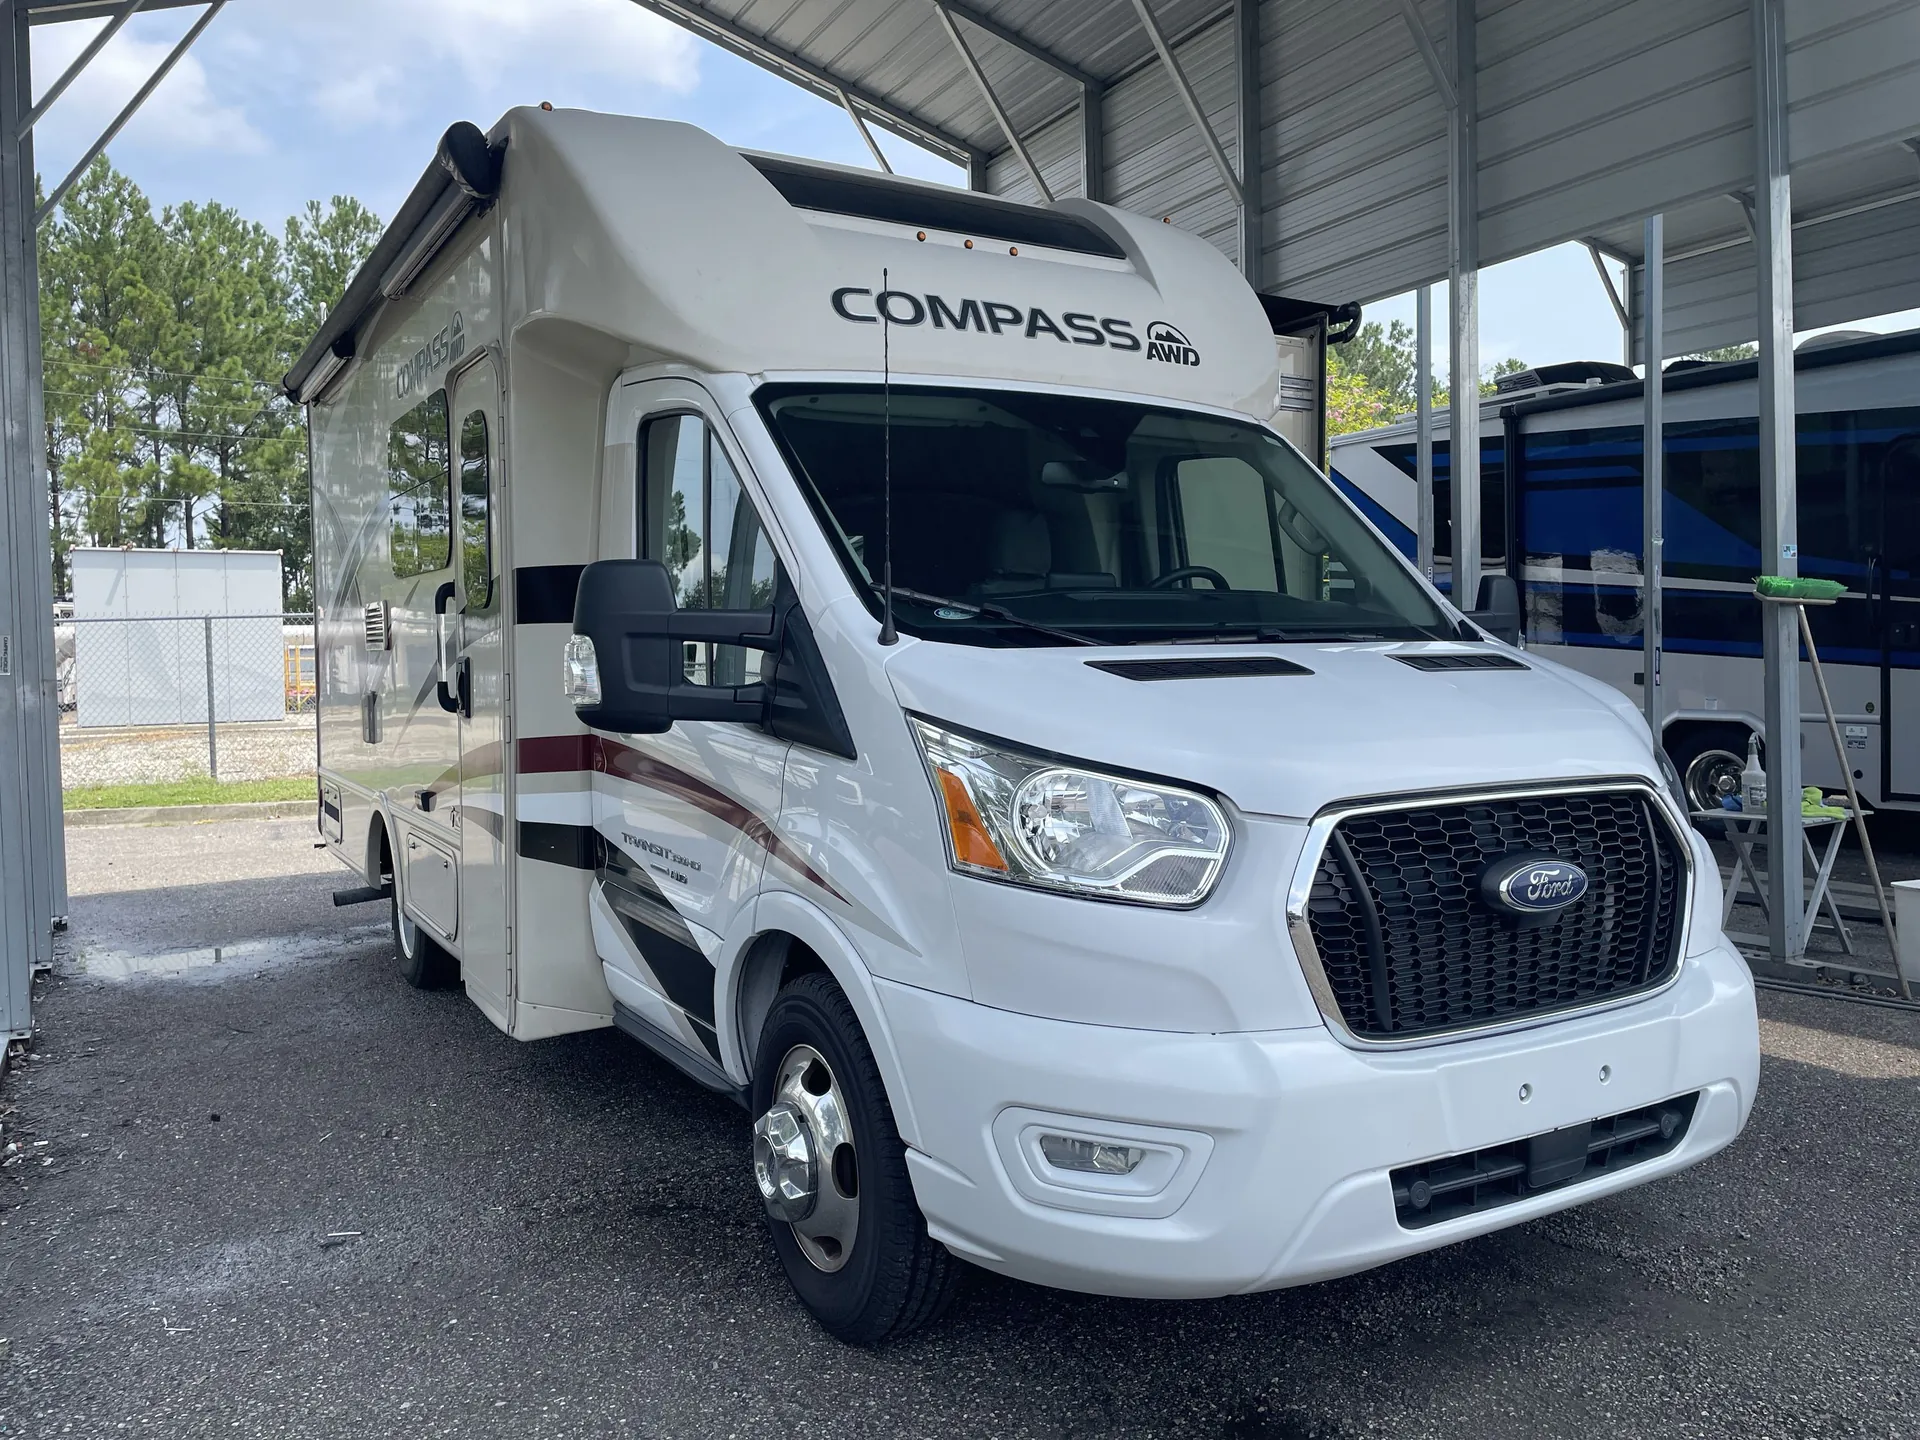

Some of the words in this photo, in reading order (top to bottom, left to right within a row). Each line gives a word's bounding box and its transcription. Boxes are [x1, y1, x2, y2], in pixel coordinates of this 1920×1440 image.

[830, 286, 1141, 352] COMPASS
[1146, 342, 1201, 367] AWD
[396, 324, 448, 400] COMPASS
[621, 831, 672, 860] TRANSIT
[1527, 869, 1574, 901] Ford
